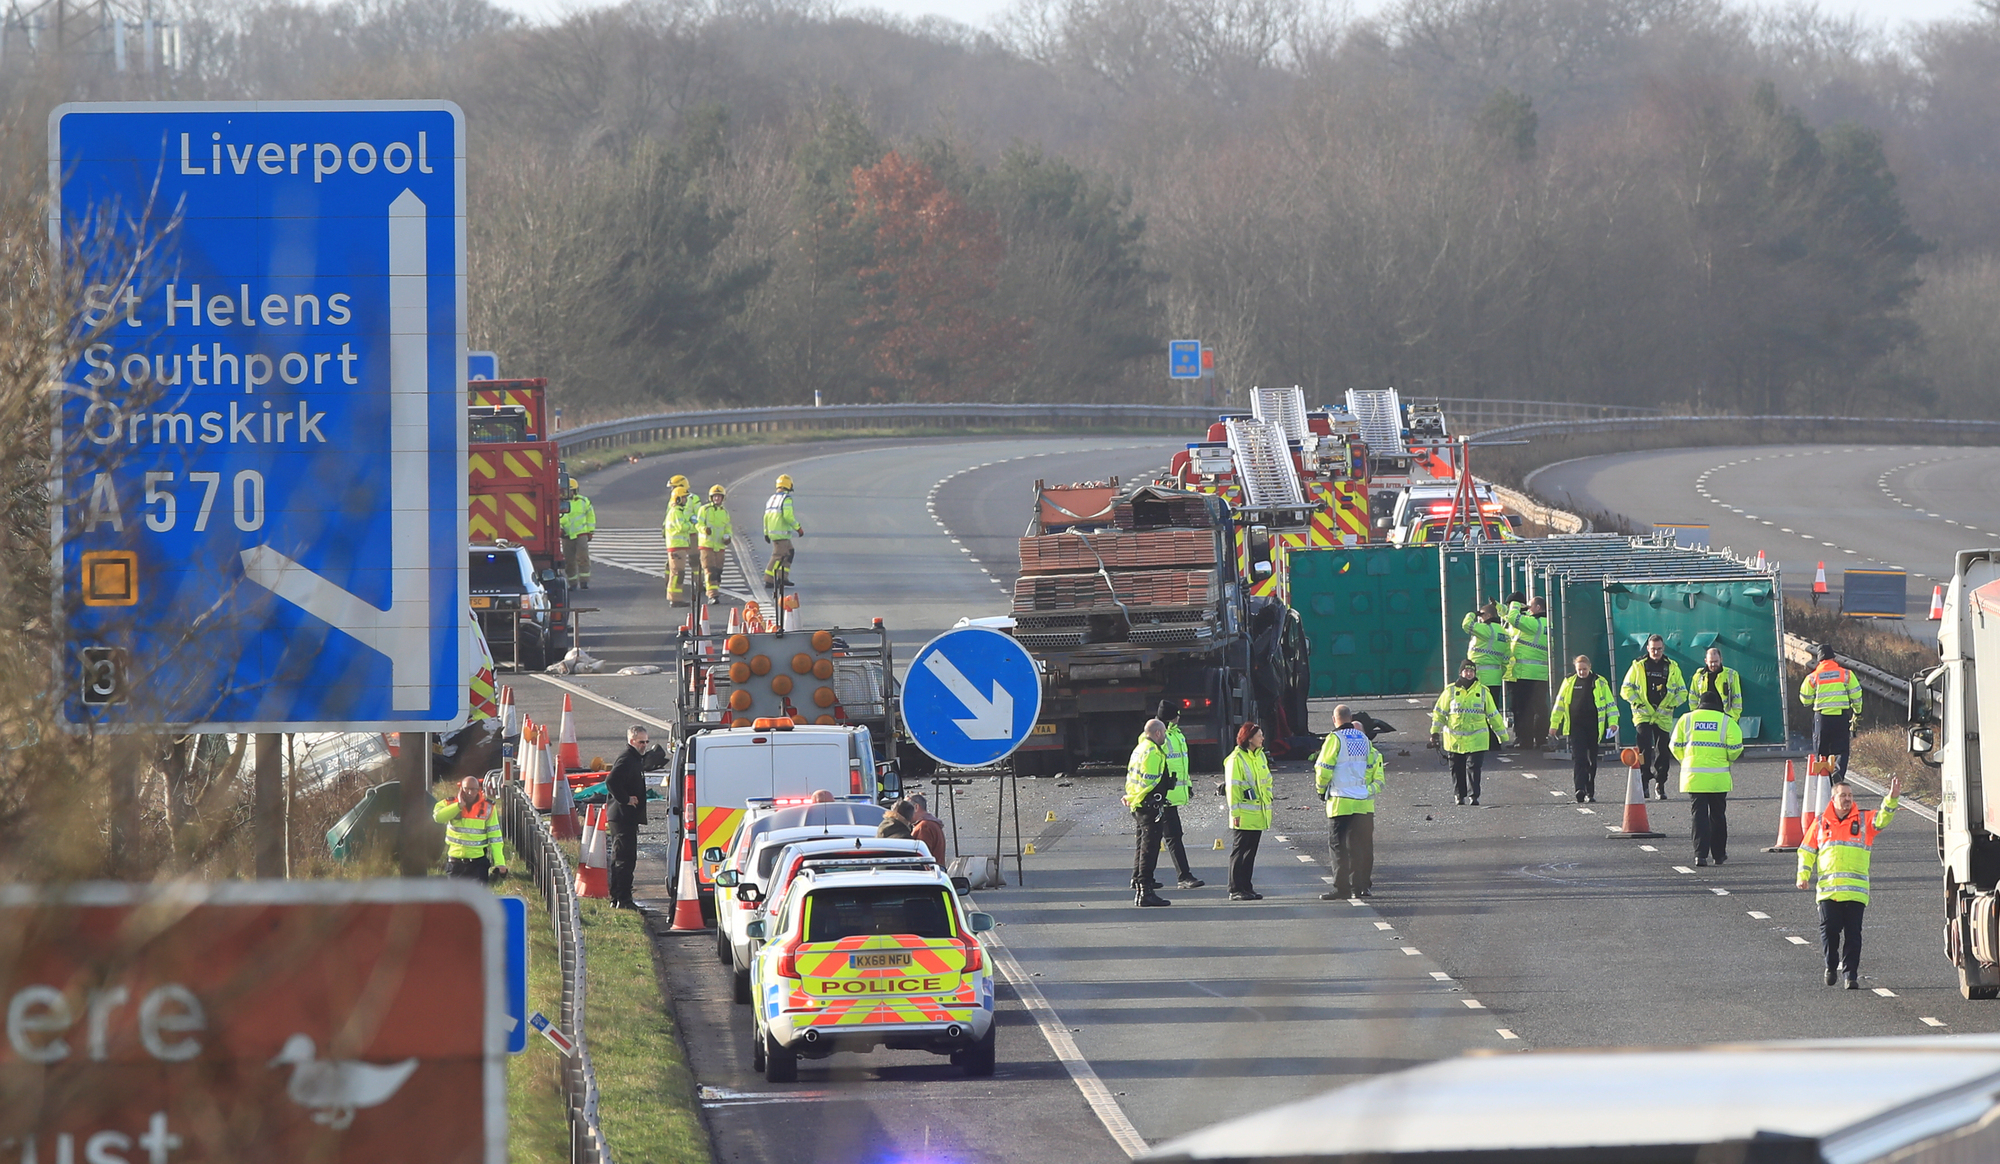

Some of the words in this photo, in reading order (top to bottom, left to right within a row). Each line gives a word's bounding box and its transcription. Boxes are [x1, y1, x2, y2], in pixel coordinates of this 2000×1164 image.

[180, 130, 434, 184] Liverpool
[83, 283, 142, 327] St
[166, 283, 352, 327] Helens
[83, 342, 358, 394] Southport
[83, 400, 327, 445] Ormskirk
[145, 469, 265, 533] 570
[92, 659, 116, 695] 3
[1695, 722, 1717, 730] POLICE
[856, 955, 886, 967] KX68
[888, 953, 911, 965] NFU
[822, 978, 941, 993] POLICE
[5, 983, 206, 1063] ere
